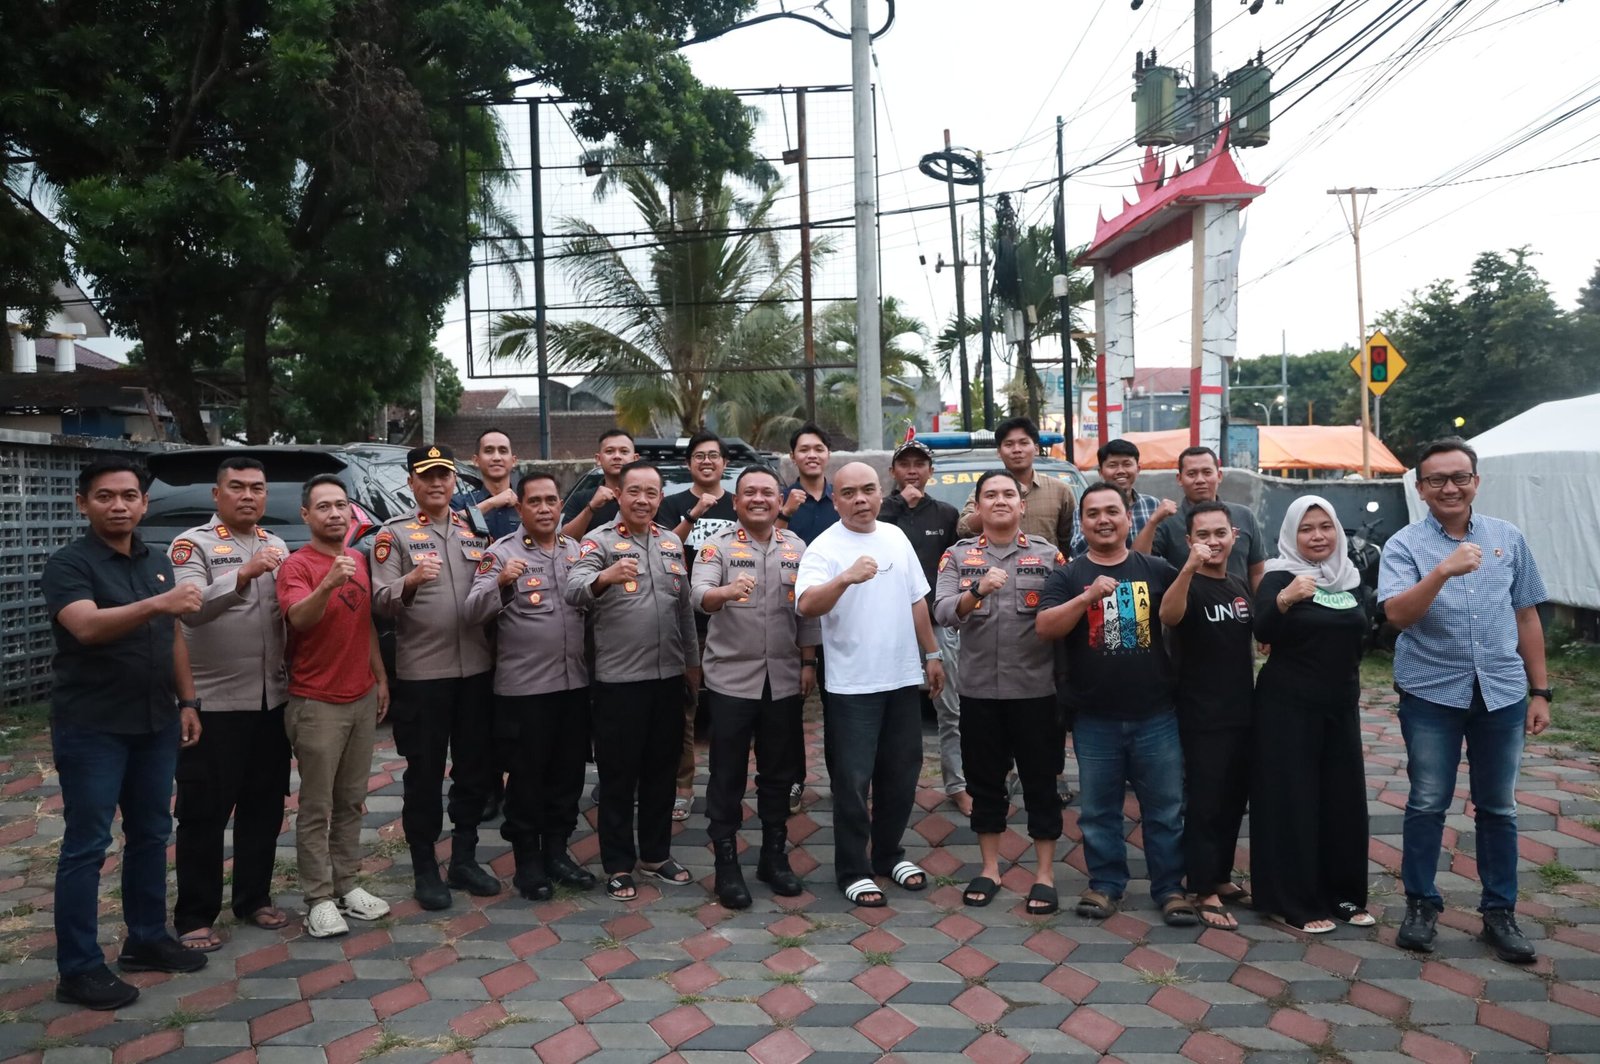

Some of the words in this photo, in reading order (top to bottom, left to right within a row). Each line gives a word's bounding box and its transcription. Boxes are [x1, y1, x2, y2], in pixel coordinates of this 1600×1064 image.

[461, 540, 483, 548] POLRI
[781, 561, 800, 569] POLR
[1016, 567, 1045, 575] POLRI
